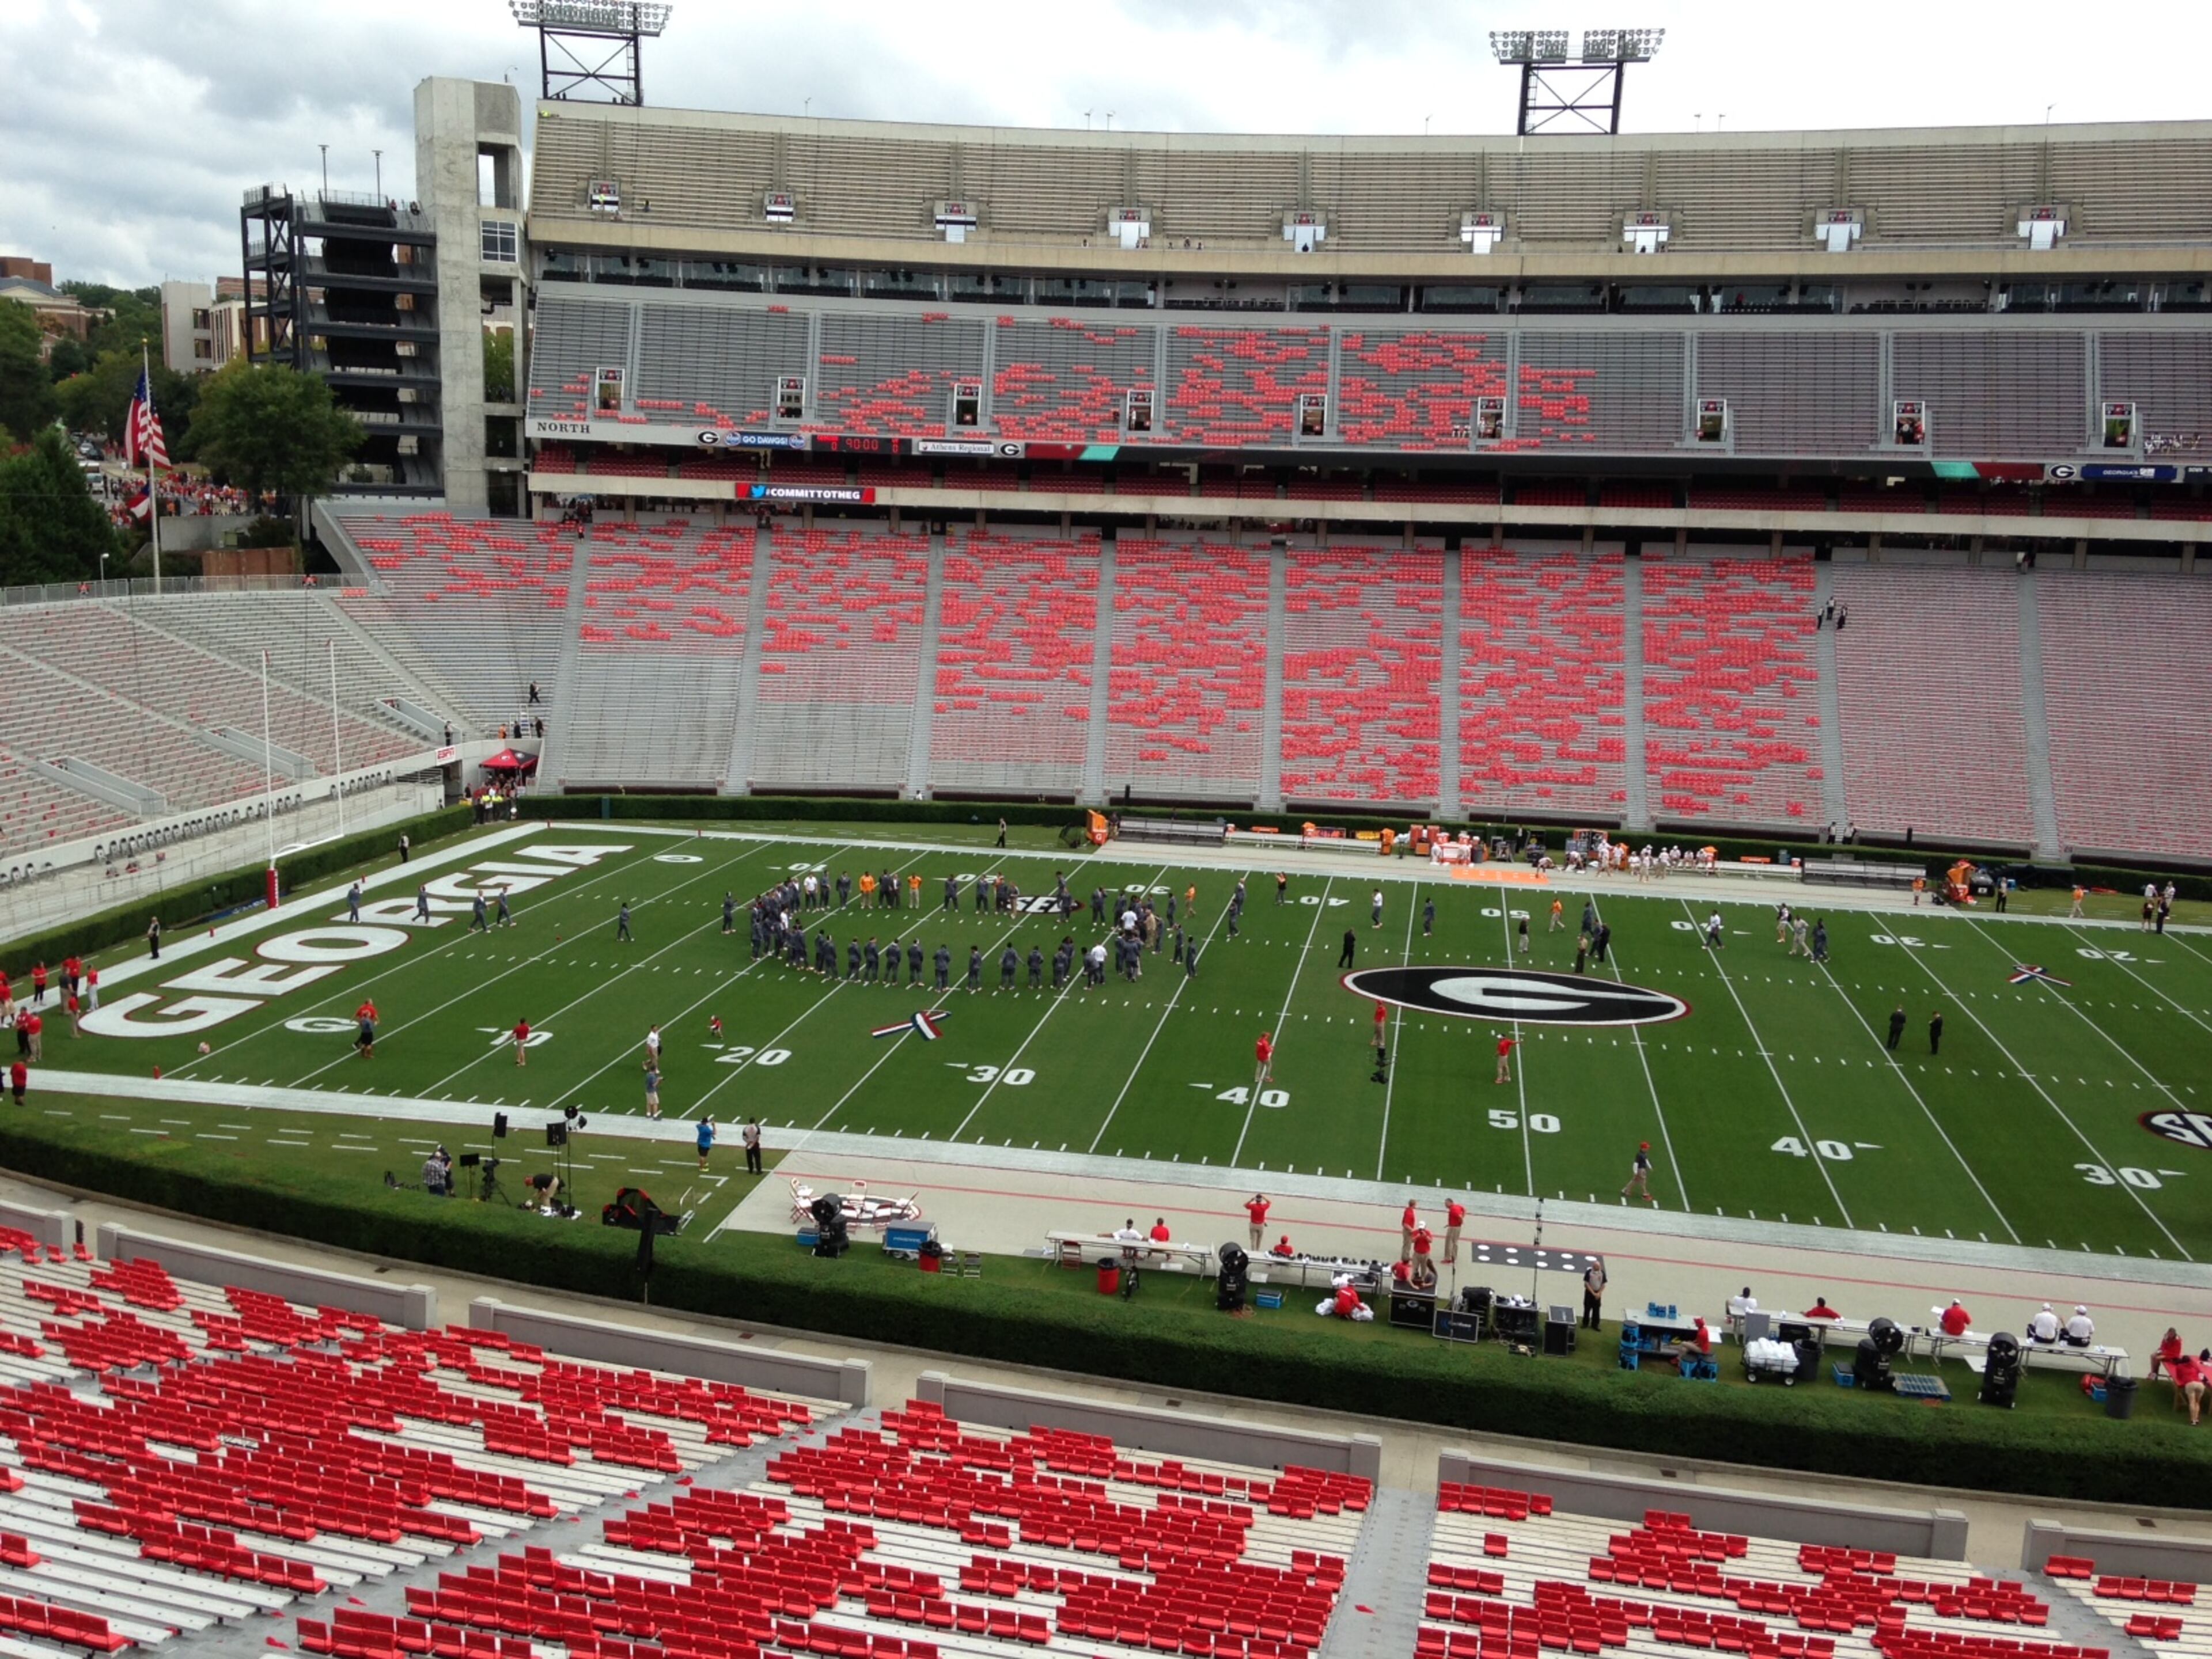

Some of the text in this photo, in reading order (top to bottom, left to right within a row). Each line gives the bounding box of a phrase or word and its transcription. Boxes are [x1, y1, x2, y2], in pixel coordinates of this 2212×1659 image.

[537, 422, 590, 434] NORTH
[742, 435, 756, 444] GO
[757, 436, 789, 445] DAWGS!
[959, 444, 991, 453] Regional
[766, 488, 860, 499] #COMMITTOTHEG
[1125, 884, 1171, 894] 30
[1300, 896, 1350, 906] 40
[1480, 908, 1531, 919] 50
[78, 844, 635, 1037] GEORGIA
[1870, 934, 1925, 946] 30
[2076, 948, 2138, 962] 20
[715, 1046, 792, 1066] 20
[966, 1065, 1036, 1086] 30
[1215, 1086, 1290, 1108] 40
[1488, 1109, 1561, 1133] 50
[1770, 1136, 1854, 1161] 40
[2074, 1164, 2162, 1189] 30
